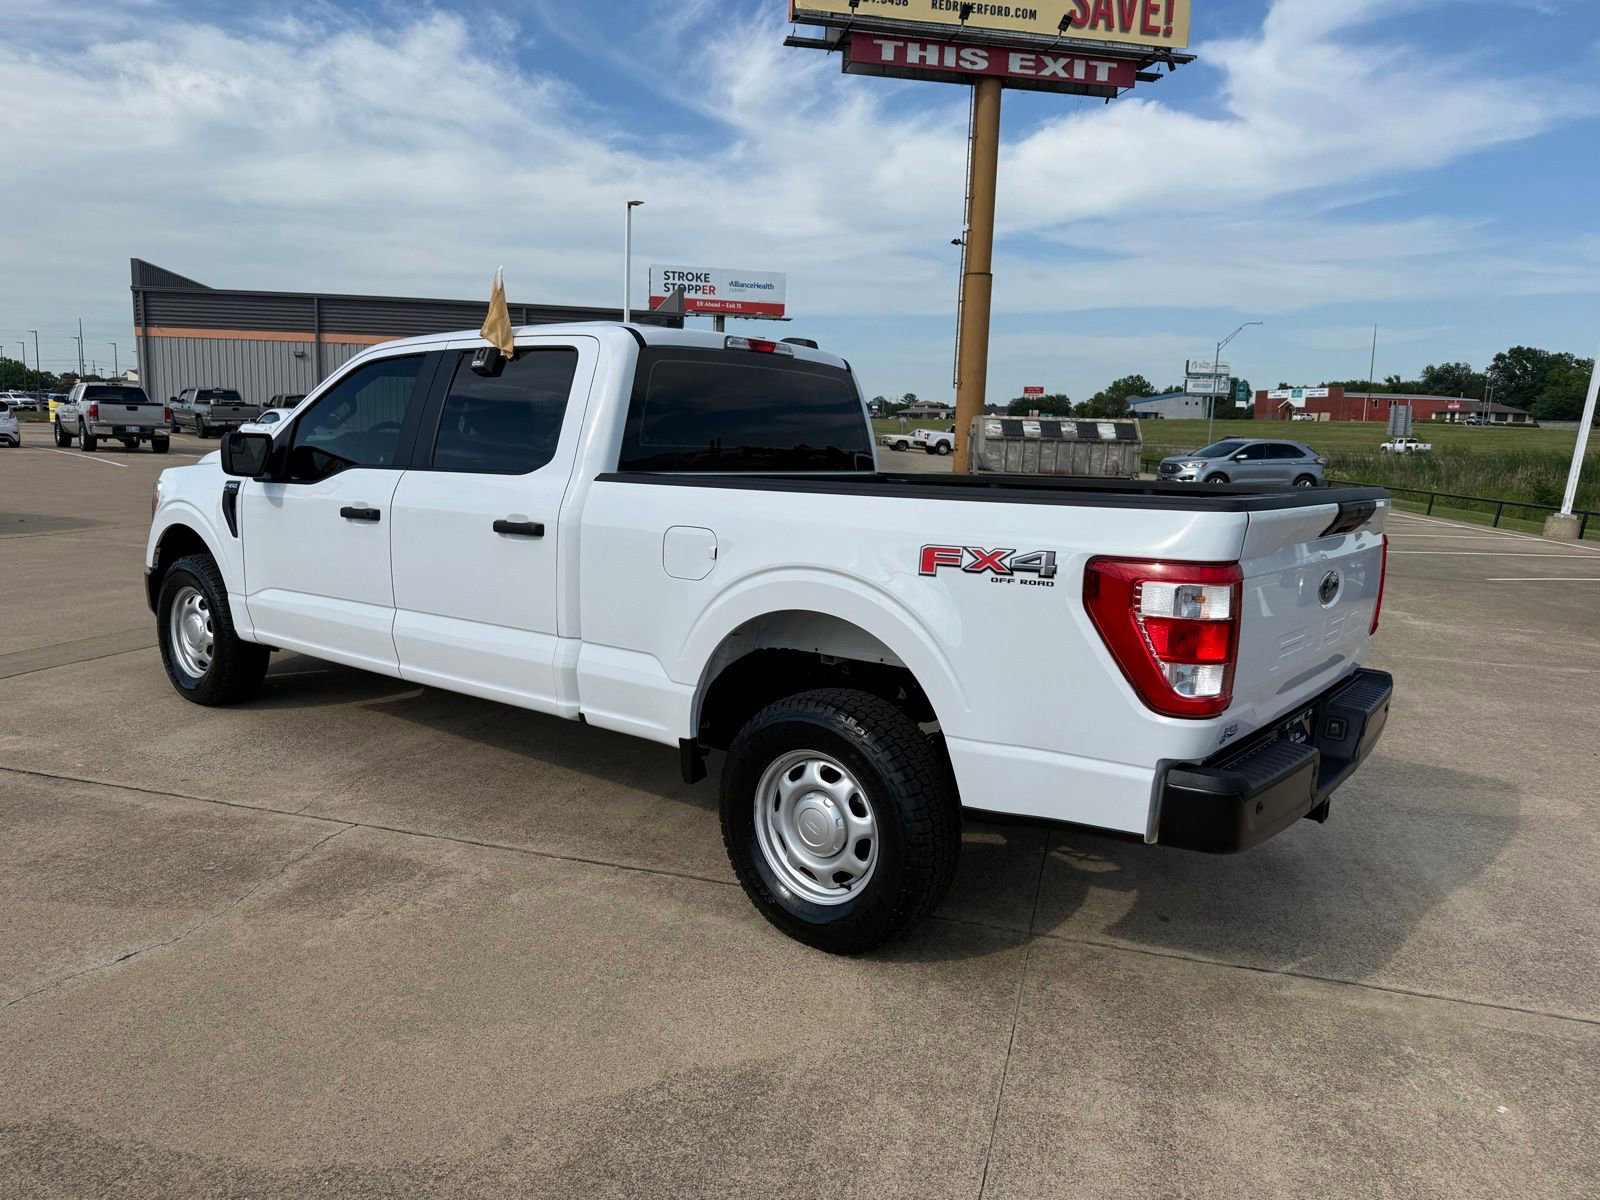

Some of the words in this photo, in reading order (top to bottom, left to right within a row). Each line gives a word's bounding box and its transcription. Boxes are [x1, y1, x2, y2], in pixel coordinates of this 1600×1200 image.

[931, 0, 1037, 20] REDRIERFORD.COM
[872, 39, 989, 70] THIS
[1008, 52, 1118, 82] EXIT
[663, 270, 711, 283] STROKE
[663, 282, 716, 295] STOPPER
[918, 543, 1058, 579] FX4
[990, 576, 1016, 585] OFF
[1019, 579, 1056, 588] ROAD
